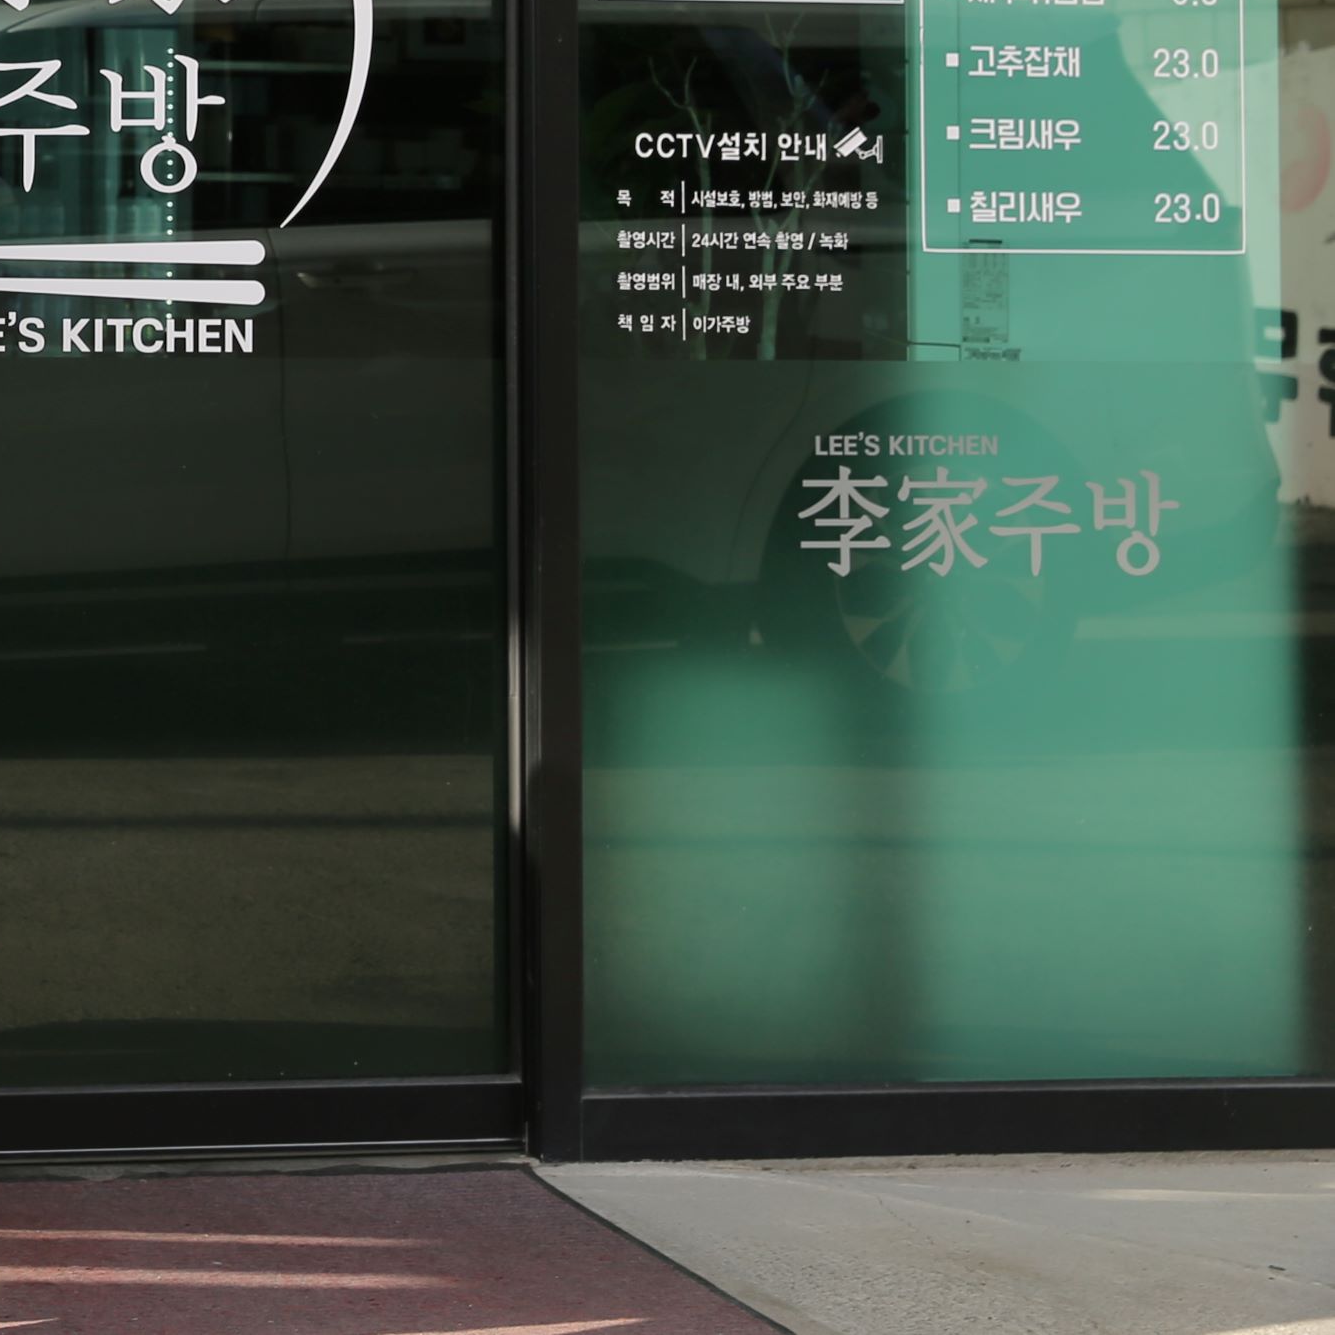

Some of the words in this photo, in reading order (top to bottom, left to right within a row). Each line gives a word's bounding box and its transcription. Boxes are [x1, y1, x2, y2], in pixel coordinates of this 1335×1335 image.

[968, 46, 1081, 79] 고추잡채
[1152, 48, 1219, 79] 23.0
[634, 132, 767, 161] CCTV설치
[777, 133, 827, 161] 안내
[969, 118, 1082, 151] 크림새우
[1152, 121, 1219, 151] 23.0
[691, 190, 745, 209] 시설보호,
[748, 191, 777, 209] 방범,
[780, 191, 809, 209] 보안,
[813, 191, 863, 209] 화재예방
[865, 191, 878, 209] 등
[969, 191, 1083, 224] 칠리새우
[1153, 193, 1220, 224] 23.0
[617, 230, 675, 249] 촬영시간
[691, 232, 738, 249] 24시간
[742, 232, 771, 249] 연속
[775, 232, 803, 250] 촬영
[819, 232, 848, 250] 녹화
[617, 272, 675, 291] 촬영범위
[692, 273, 721, 291] 매장
[726, 273, 744, 292] 내,
[748, 274, 777, 291] 외부
[781, 274, 811, 291] 주요
[814, 274, 843, 292] 부분
[62, 317, 254, 353] KITCHEN
[693, 315, 751, 334] 이가주방
[815, 431, 881, 456] LEE'S
[889, 434, 998, 456] KITCHEN
[797, 465, 1180, 577] 李家주방
